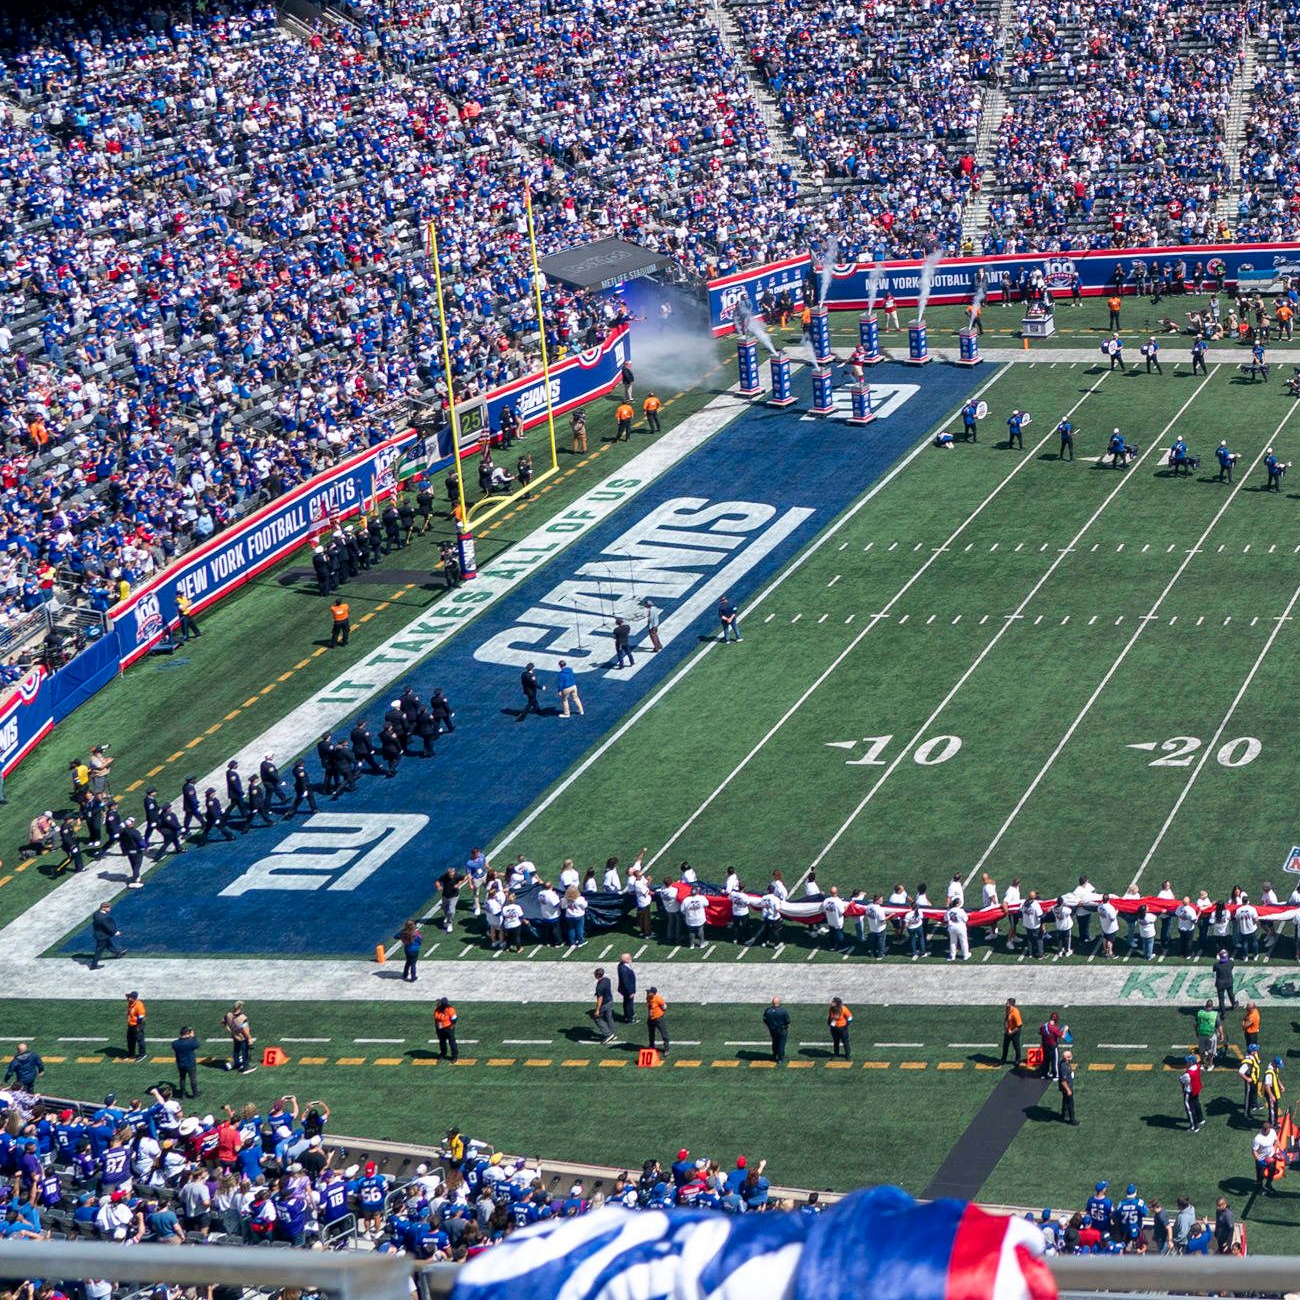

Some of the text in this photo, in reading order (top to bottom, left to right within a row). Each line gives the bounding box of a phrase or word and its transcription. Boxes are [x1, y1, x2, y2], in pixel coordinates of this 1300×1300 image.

[629, 264, 657, 280] STADIUM
[462, 412, 481, 435] 25
[588, 478, 643, 501] US
[547, 509, 596, 533] OF
[176, 568, 208, 599] NEW
[210, 546, 246, 584] YORK
[248, 510, 307, 560] FOOTBALL
[491, 542, 559, 580] ALL
[472, 497, 790, 674] GIANTS
[366, 590, 493, 667] TAKES
[317, 679, 377, 704] IT
[844, 734, 963, 766] 10
[1149, 736, 1263, 767] 20
[266, 1050, 276, 1064] G
[641, 1051, 653, 1066] 10
[106, 1156, 126, 1174] 87
[330, 1192, 344, 1207] 18
[361, 1186, 382, 1203] 56
[1120, 1210, 1138, 1223] 75
